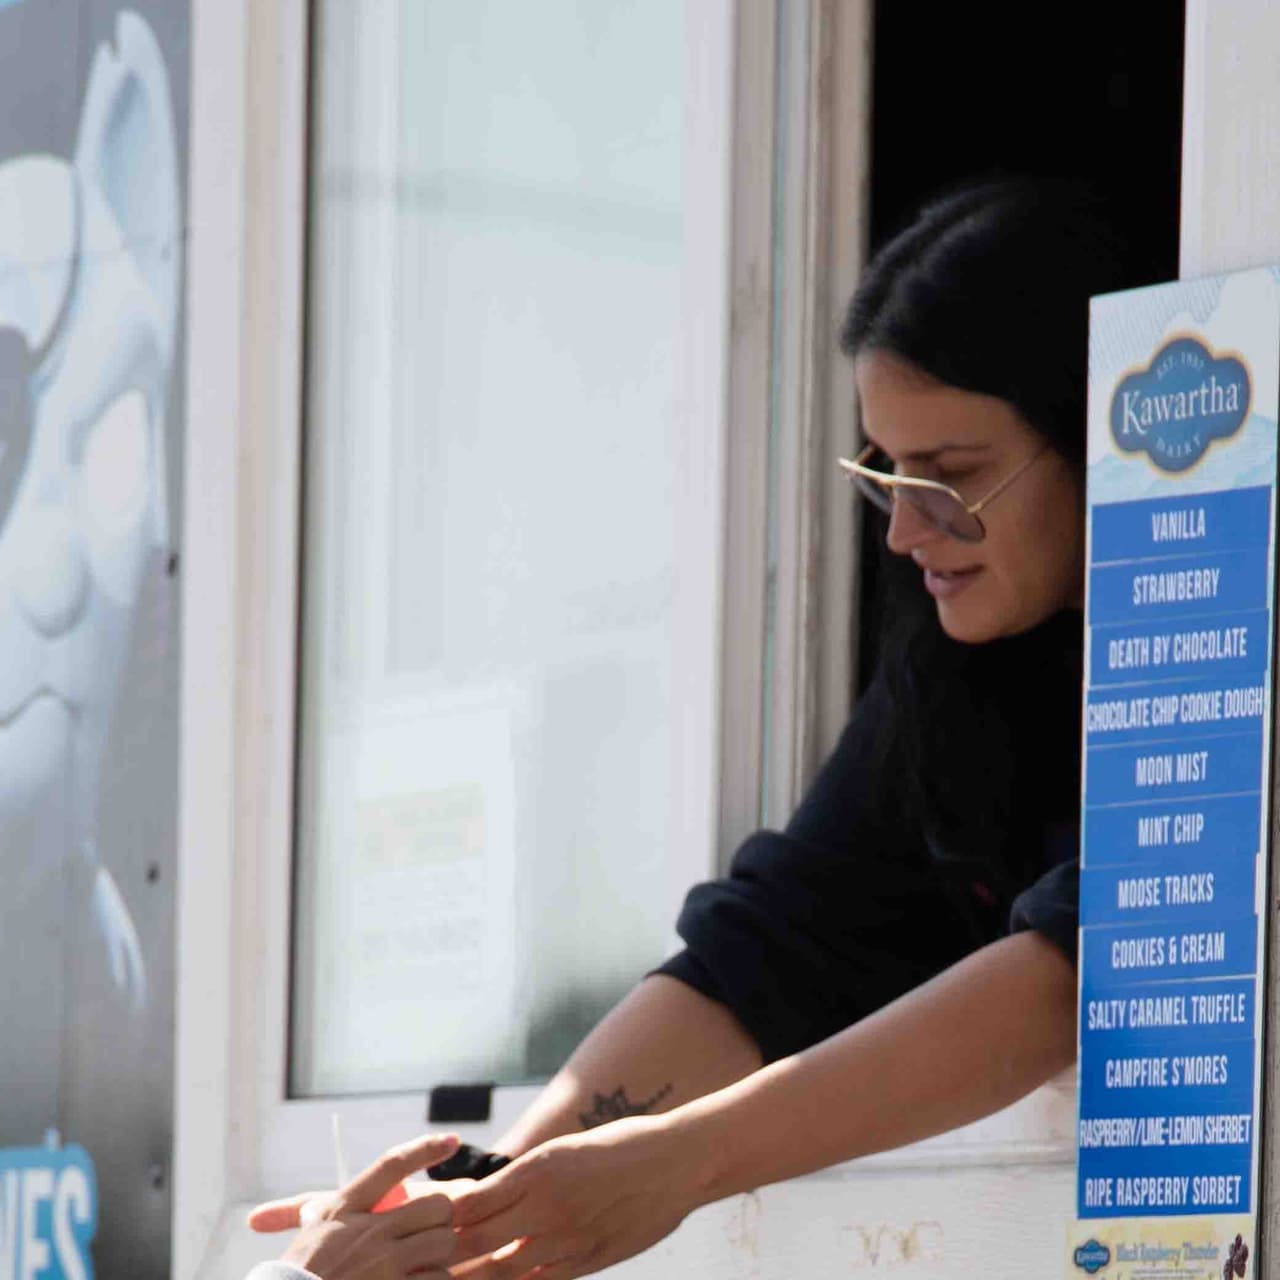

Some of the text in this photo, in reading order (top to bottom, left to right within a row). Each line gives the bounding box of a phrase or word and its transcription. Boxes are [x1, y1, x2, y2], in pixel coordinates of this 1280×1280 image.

[1122, 374, 1239, 436] Kawartha
[1151, 508, 1206, 543] VANILLA
[1132, 568, 1220, 605] STRAWBERRY
[1108, 626, 1248, 670] DEATH BY CHOCOLATE
[1086, 686, 1263, 733] CHOCOLATE CHIP COOKIE DOUGH
[1136, 751, 1209, 787] MOON MIST
[1138, 812, 1204, 847] MINT CHIP
[1117, 871, 1214, 910] MOOSE TRACKS
[1111, 931, 1225, 970] COOKIES & CREAM
[1087, 993, 1246, 1031] SALTY CARAMEL TRUFFLE
[1105, 1054, 1228, 1089] CAMPFIRE S'MORES
[1205, 1114, 1252, 1145] SHERBET
[1085, 1174, 1242, 1209] RIPE RASPBERRY SORBET
